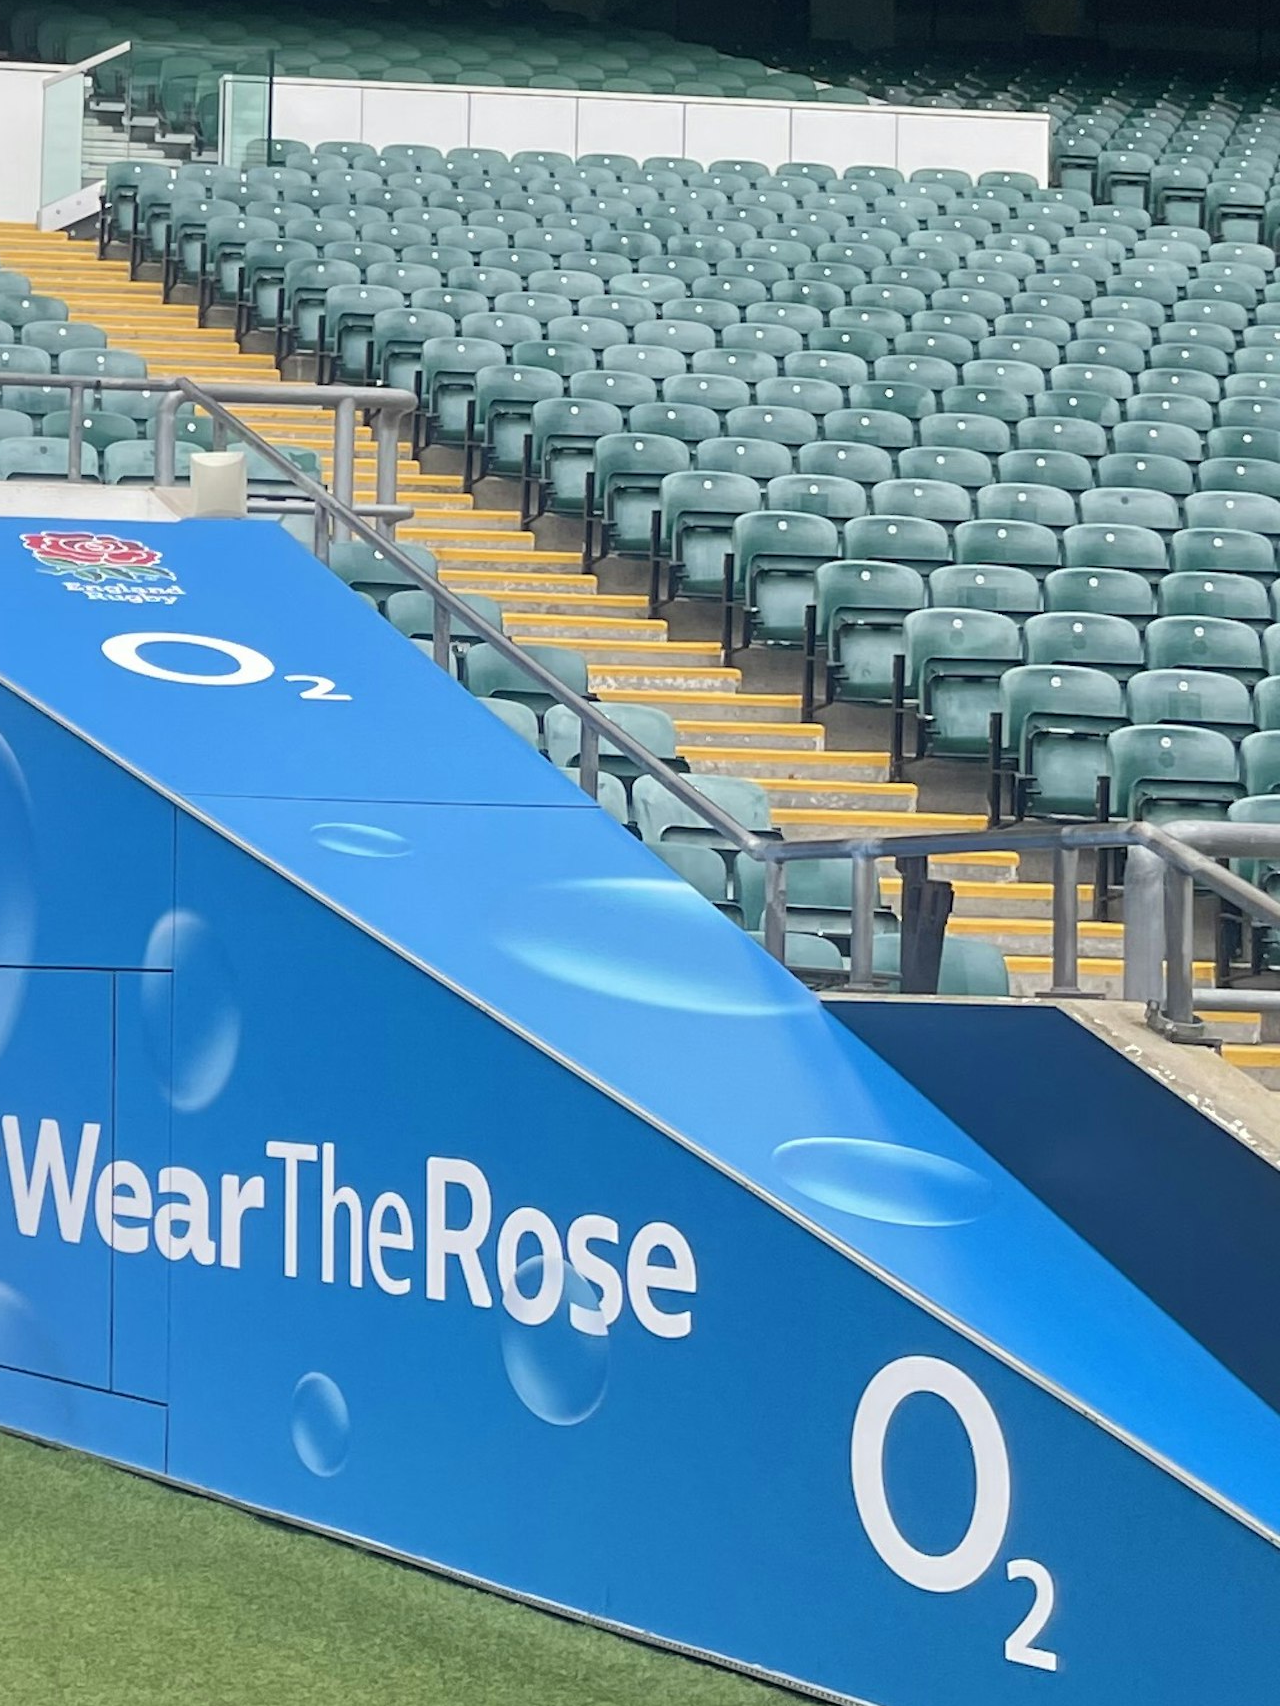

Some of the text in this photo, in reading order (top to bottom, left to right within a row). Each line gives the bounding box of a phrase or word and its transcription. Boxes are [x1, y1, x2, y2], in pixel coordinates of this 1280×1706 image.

[62, 581, 187, 596] England
[87, 591, 178, 605] Rugby
[101, 631, 353, 701] O2
[851, 1355, 1058, 1672] O2
